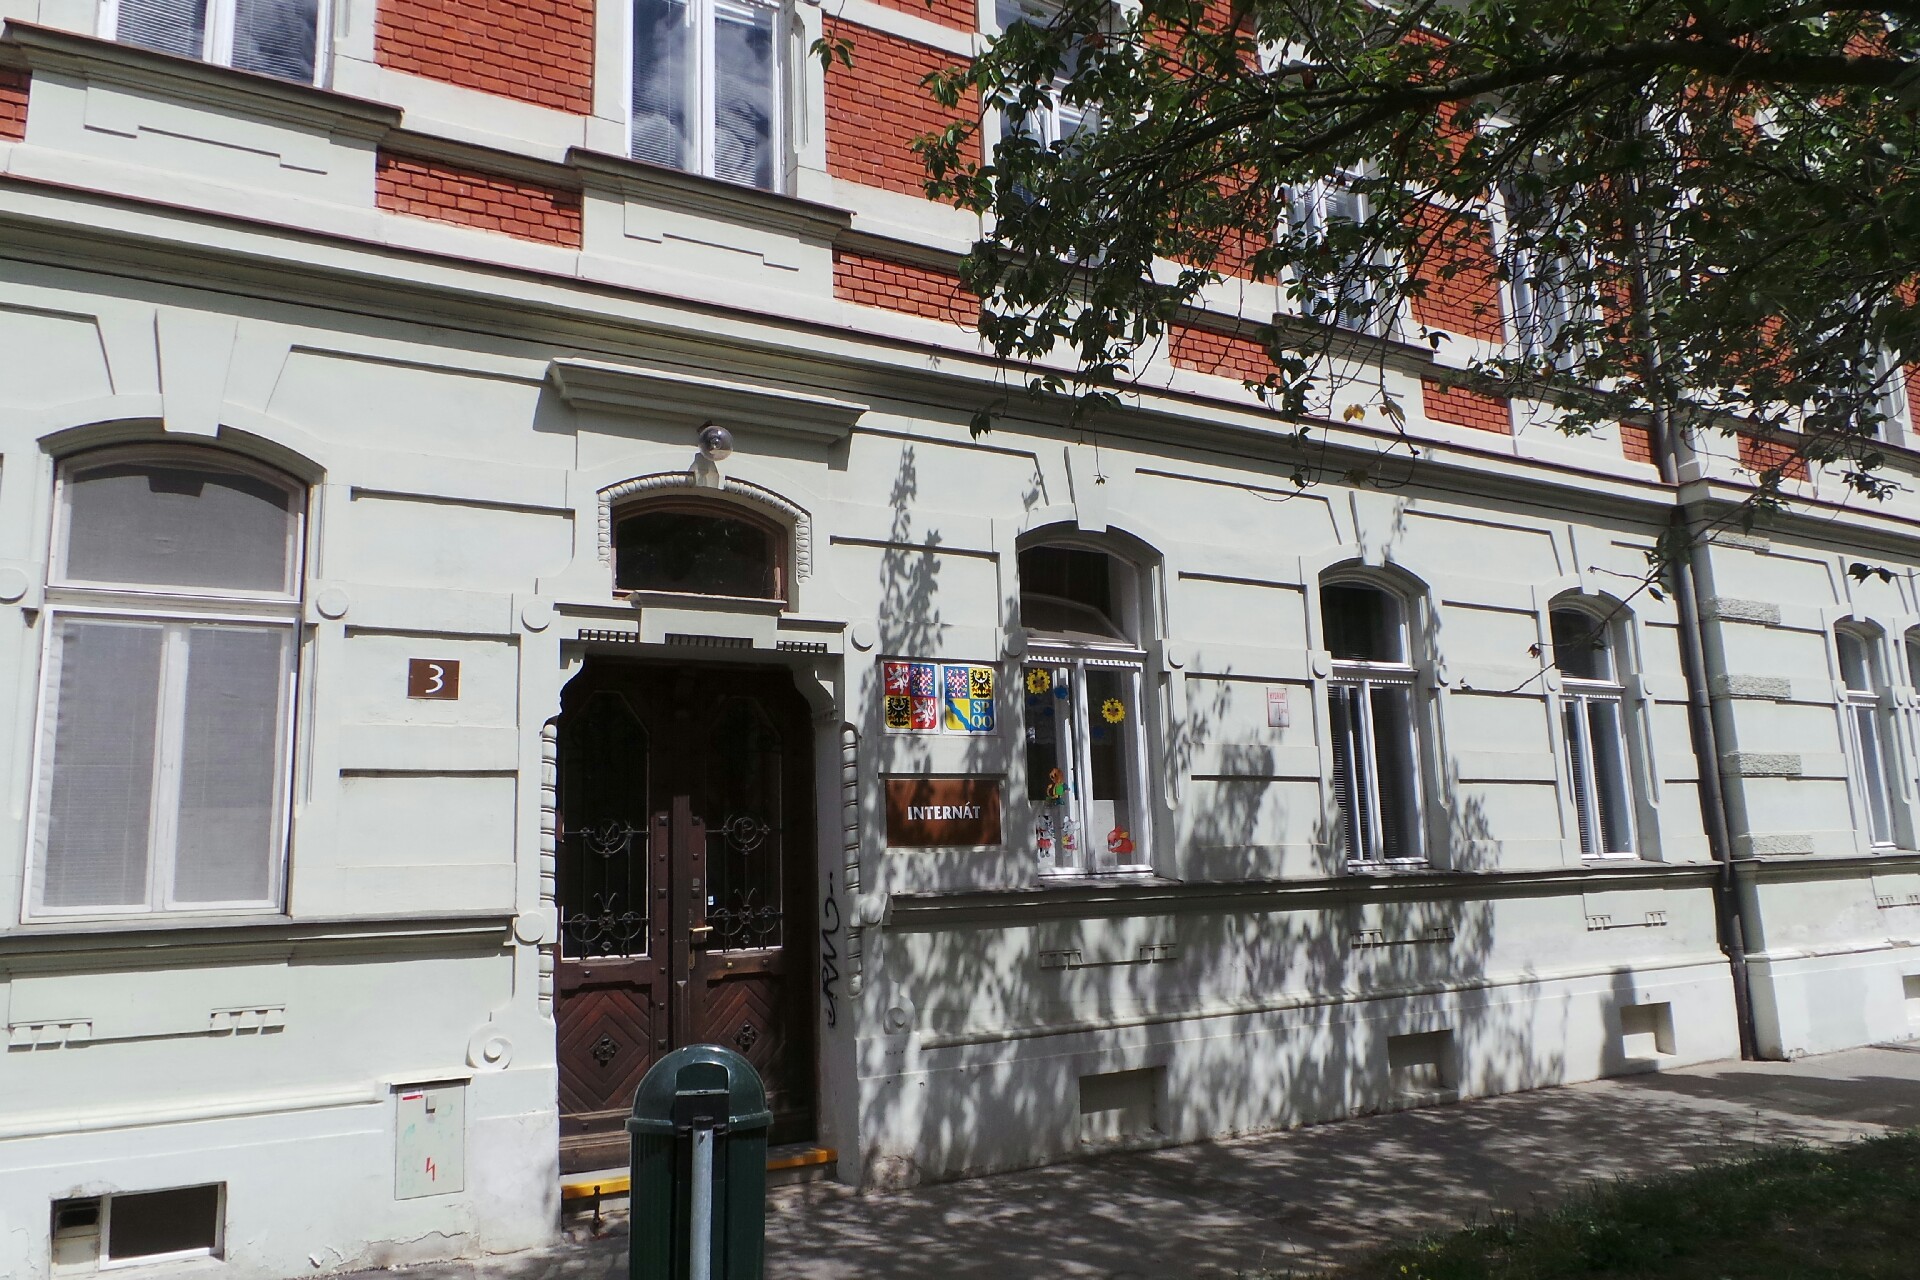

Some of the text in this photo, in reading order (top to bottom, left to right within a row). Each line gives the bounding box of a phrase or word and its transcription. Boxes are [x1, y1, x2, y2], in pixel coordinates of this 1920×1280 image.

[425, 663, 444, 694] 3
[972, 700, 990, 714] SP
[971, 714, 993, 729] QO
[907, 801, 981, 821] INTERNÁT
